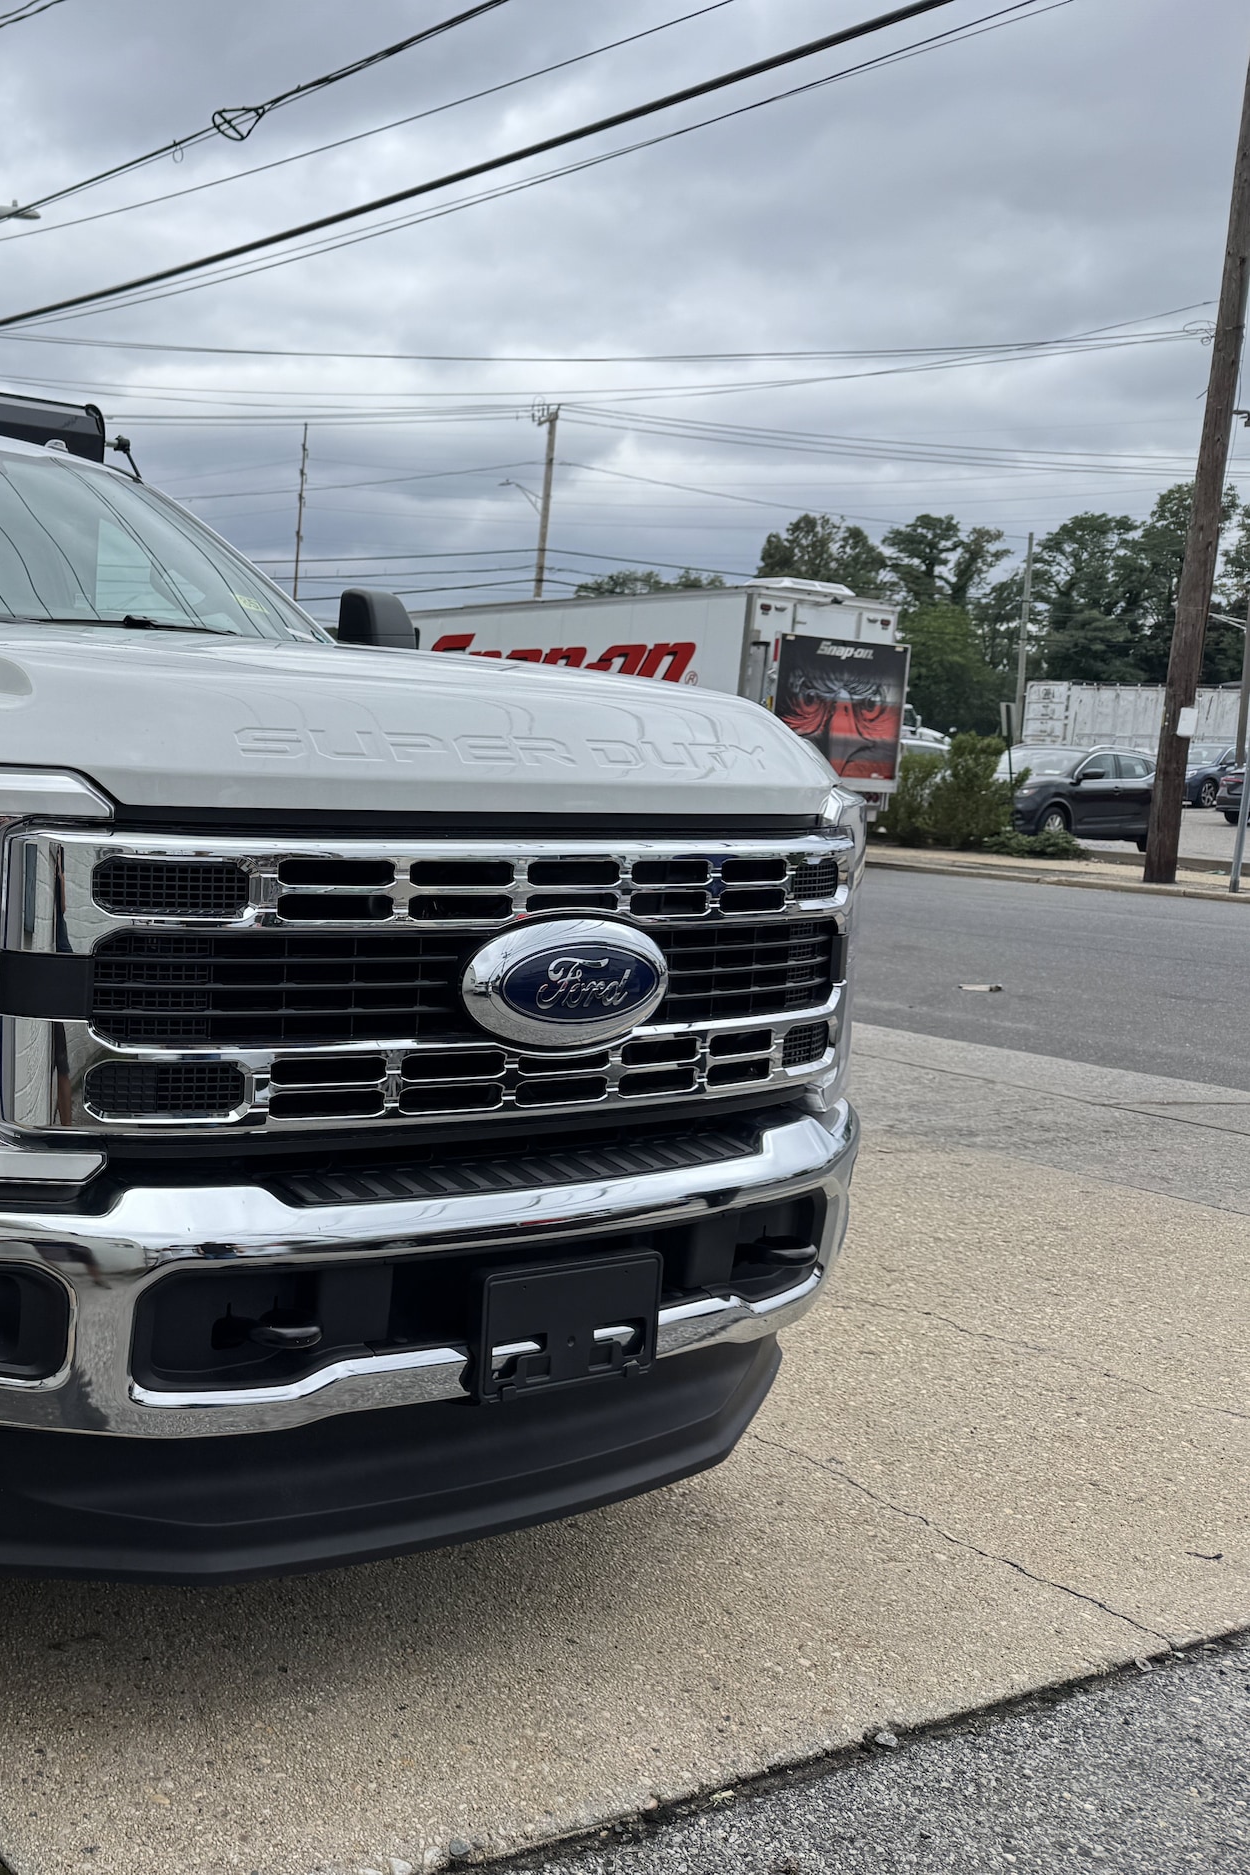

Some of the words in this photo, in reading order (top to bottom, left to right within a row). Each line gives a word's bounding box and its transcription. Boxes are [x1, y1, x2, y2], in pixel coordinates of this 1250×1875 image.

[233, 726, 578, 767] SUPER
[584, 738, 766, 771] DUTY
[536, 956, 632, 1010] Ford
